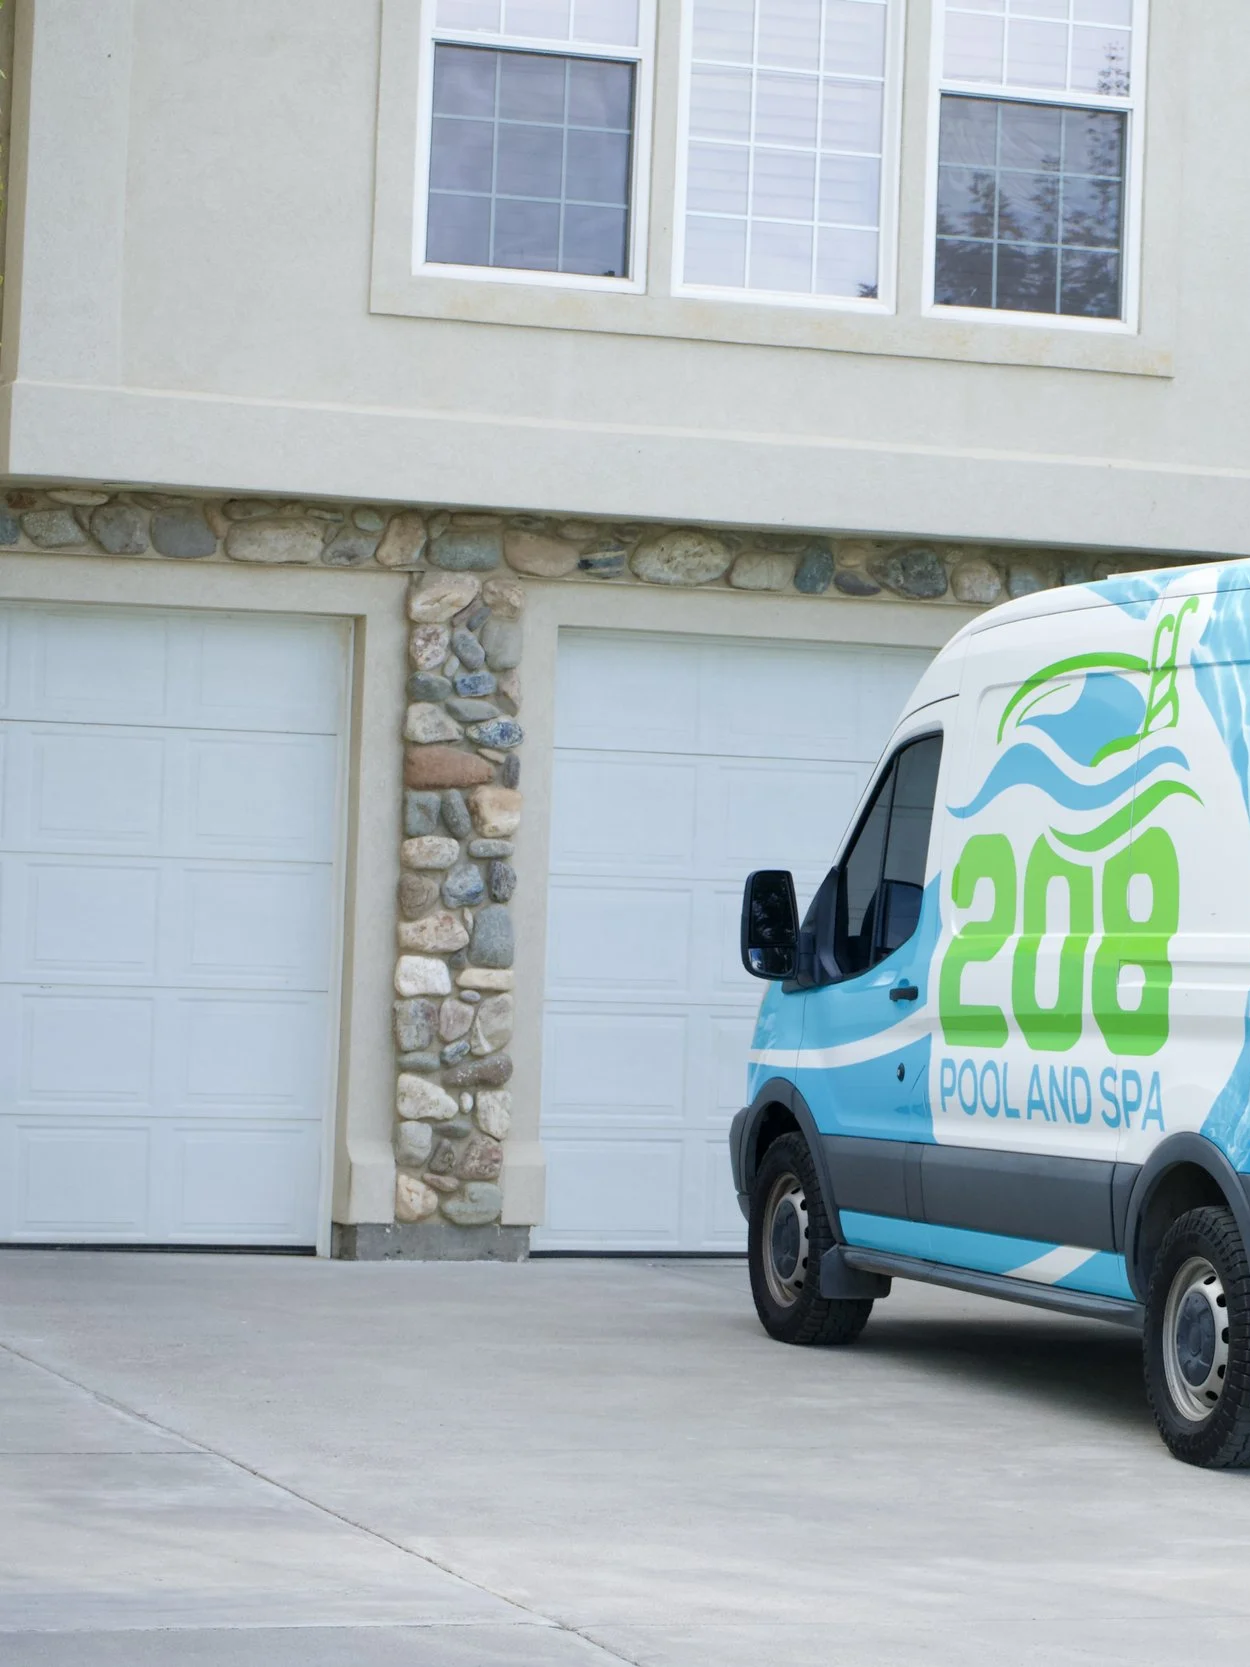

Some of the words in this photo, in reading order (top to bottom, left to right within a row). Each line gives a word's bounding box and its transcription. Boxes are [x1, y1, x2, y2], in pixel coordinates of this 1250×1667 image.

[939, 826, 1179, 1057] 208
[940, 1057, 1021, 1120] POOL
[1026, 1063, 1093, 1126] AND
[1099, 1066, 1166, 1133] SPA
